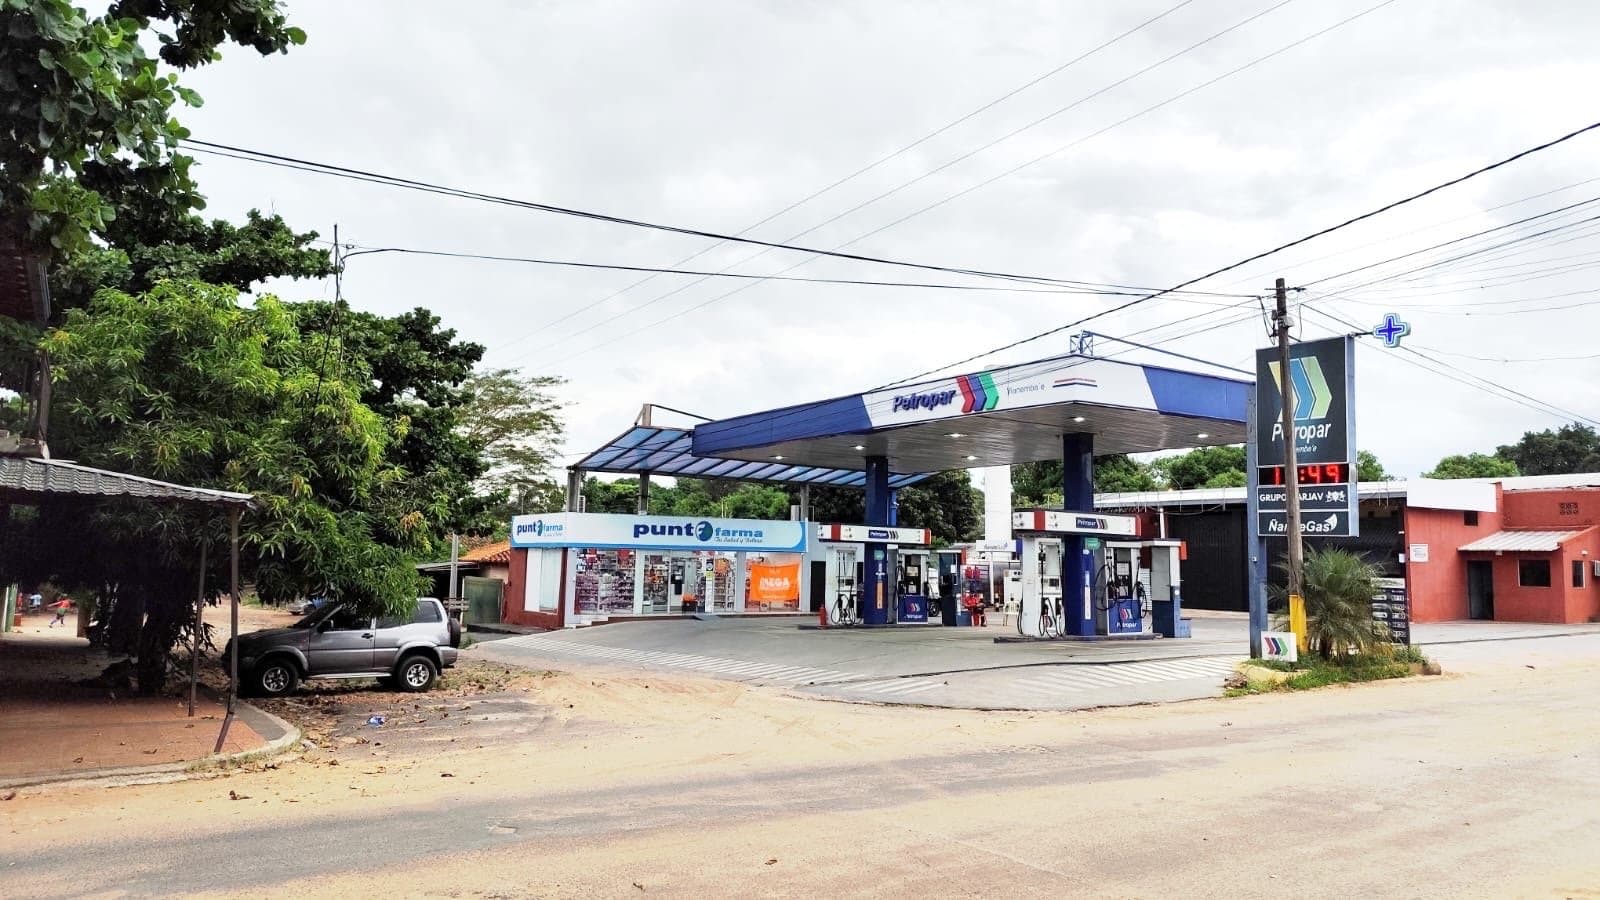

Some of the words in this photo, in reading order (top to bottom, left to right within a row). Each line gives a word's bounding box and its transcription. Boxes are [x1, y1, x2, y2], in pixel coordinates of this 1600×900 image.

[893, 389, 957, 412] Petropar
[1271, 422, 1332, 443] Propar
[1273, 464, 1339, 486] 1:49
[1259, 493, 1287, 502] GRUPO
[1298, 492, 1324, 501] ARJAV
[714, 527, 763, 537] farma
[1268, 518, 1330, 533] ÑaeGas
